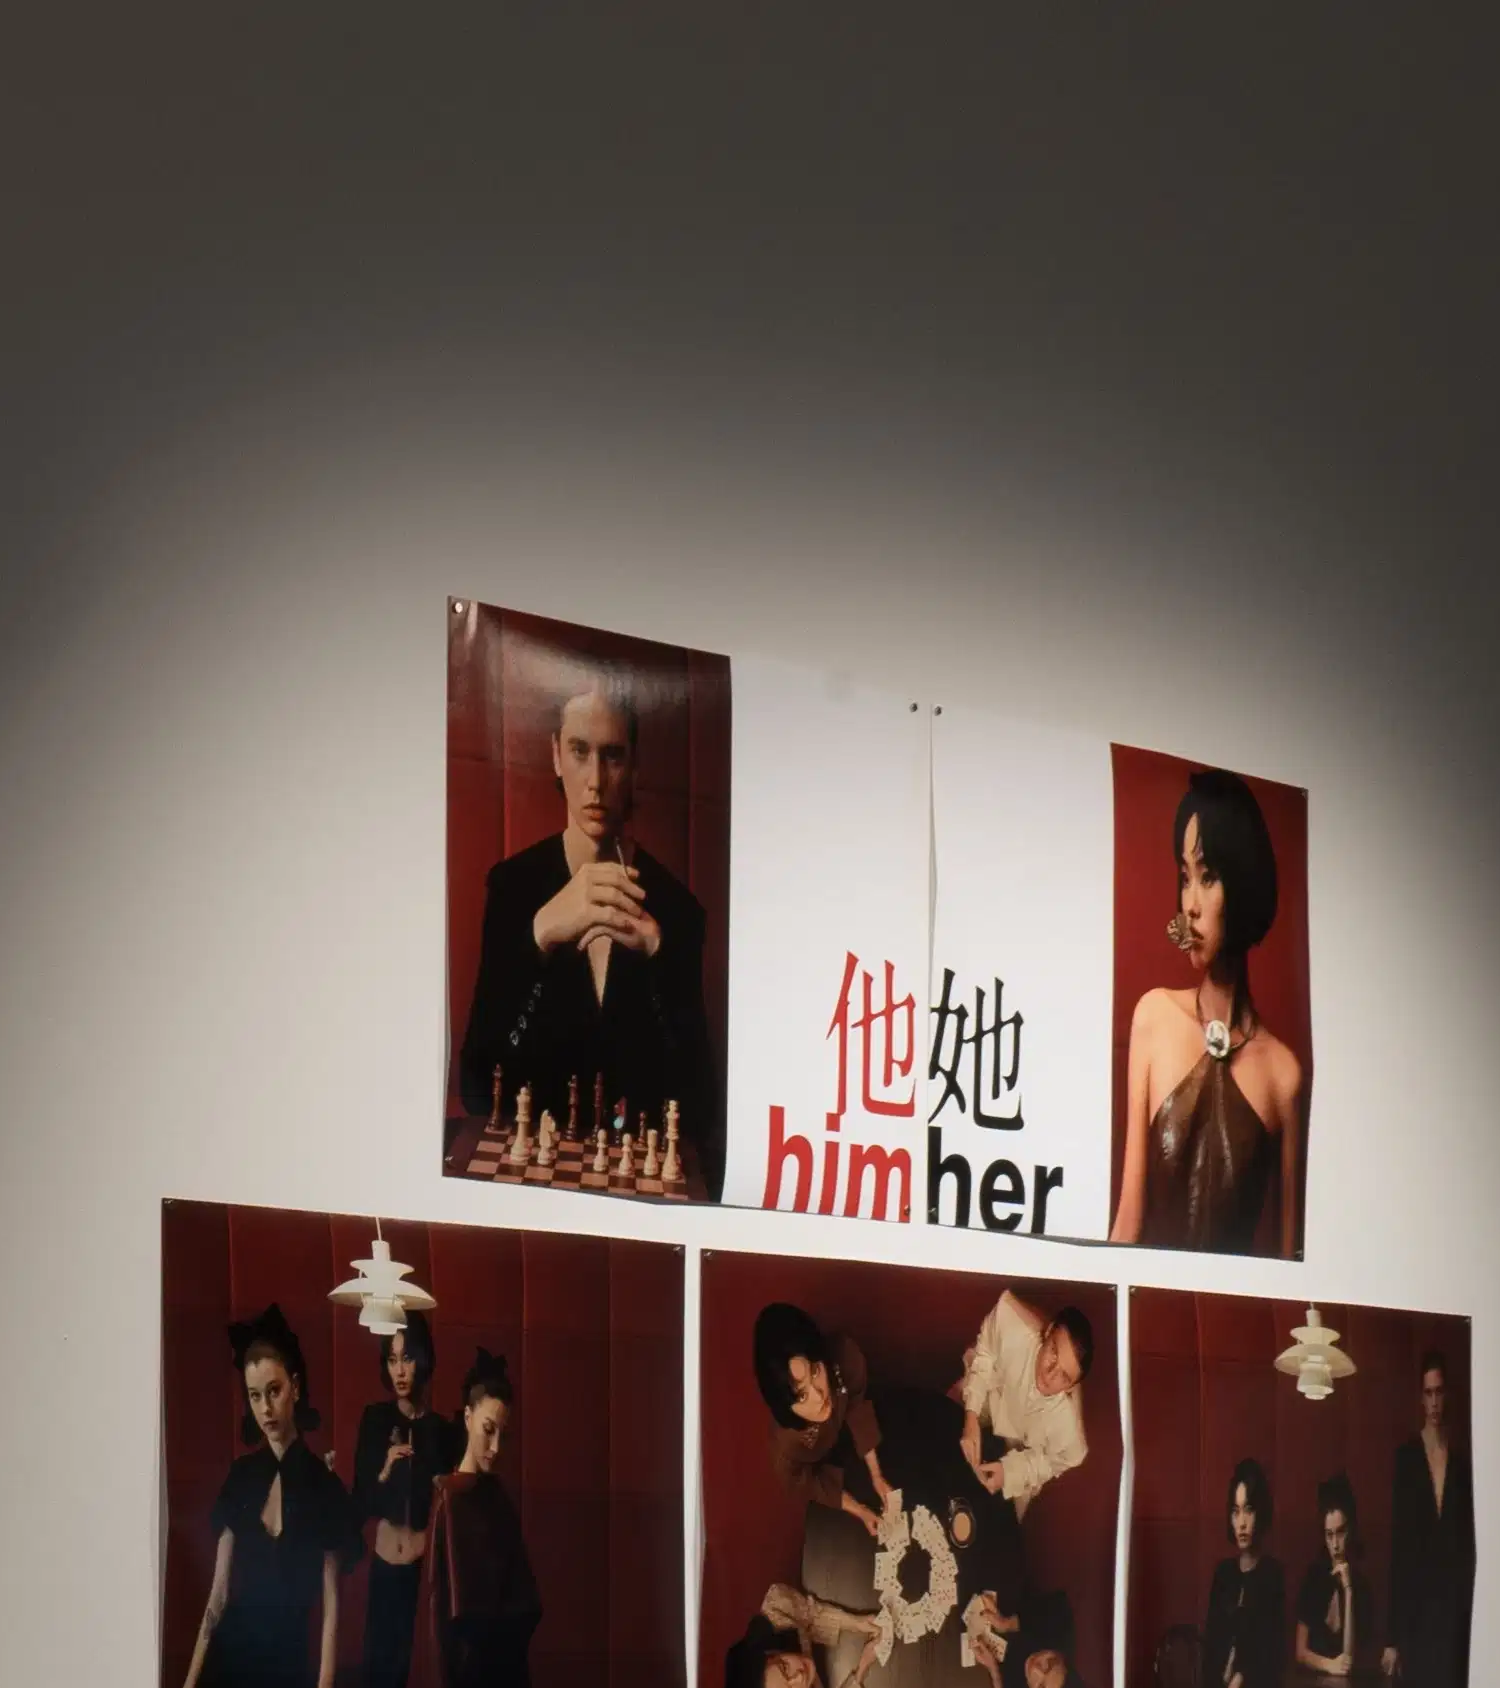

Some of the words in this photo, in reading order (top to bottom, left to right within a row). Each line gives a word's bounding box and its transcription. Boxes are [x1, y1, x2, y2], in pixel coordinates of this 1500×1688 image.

[826, 951, 917, 1117] 他
[928, 968, 1024, 1131] 她
[763, 1104, 911, 1223] him
[927, 1125, 1064, 1234] her
